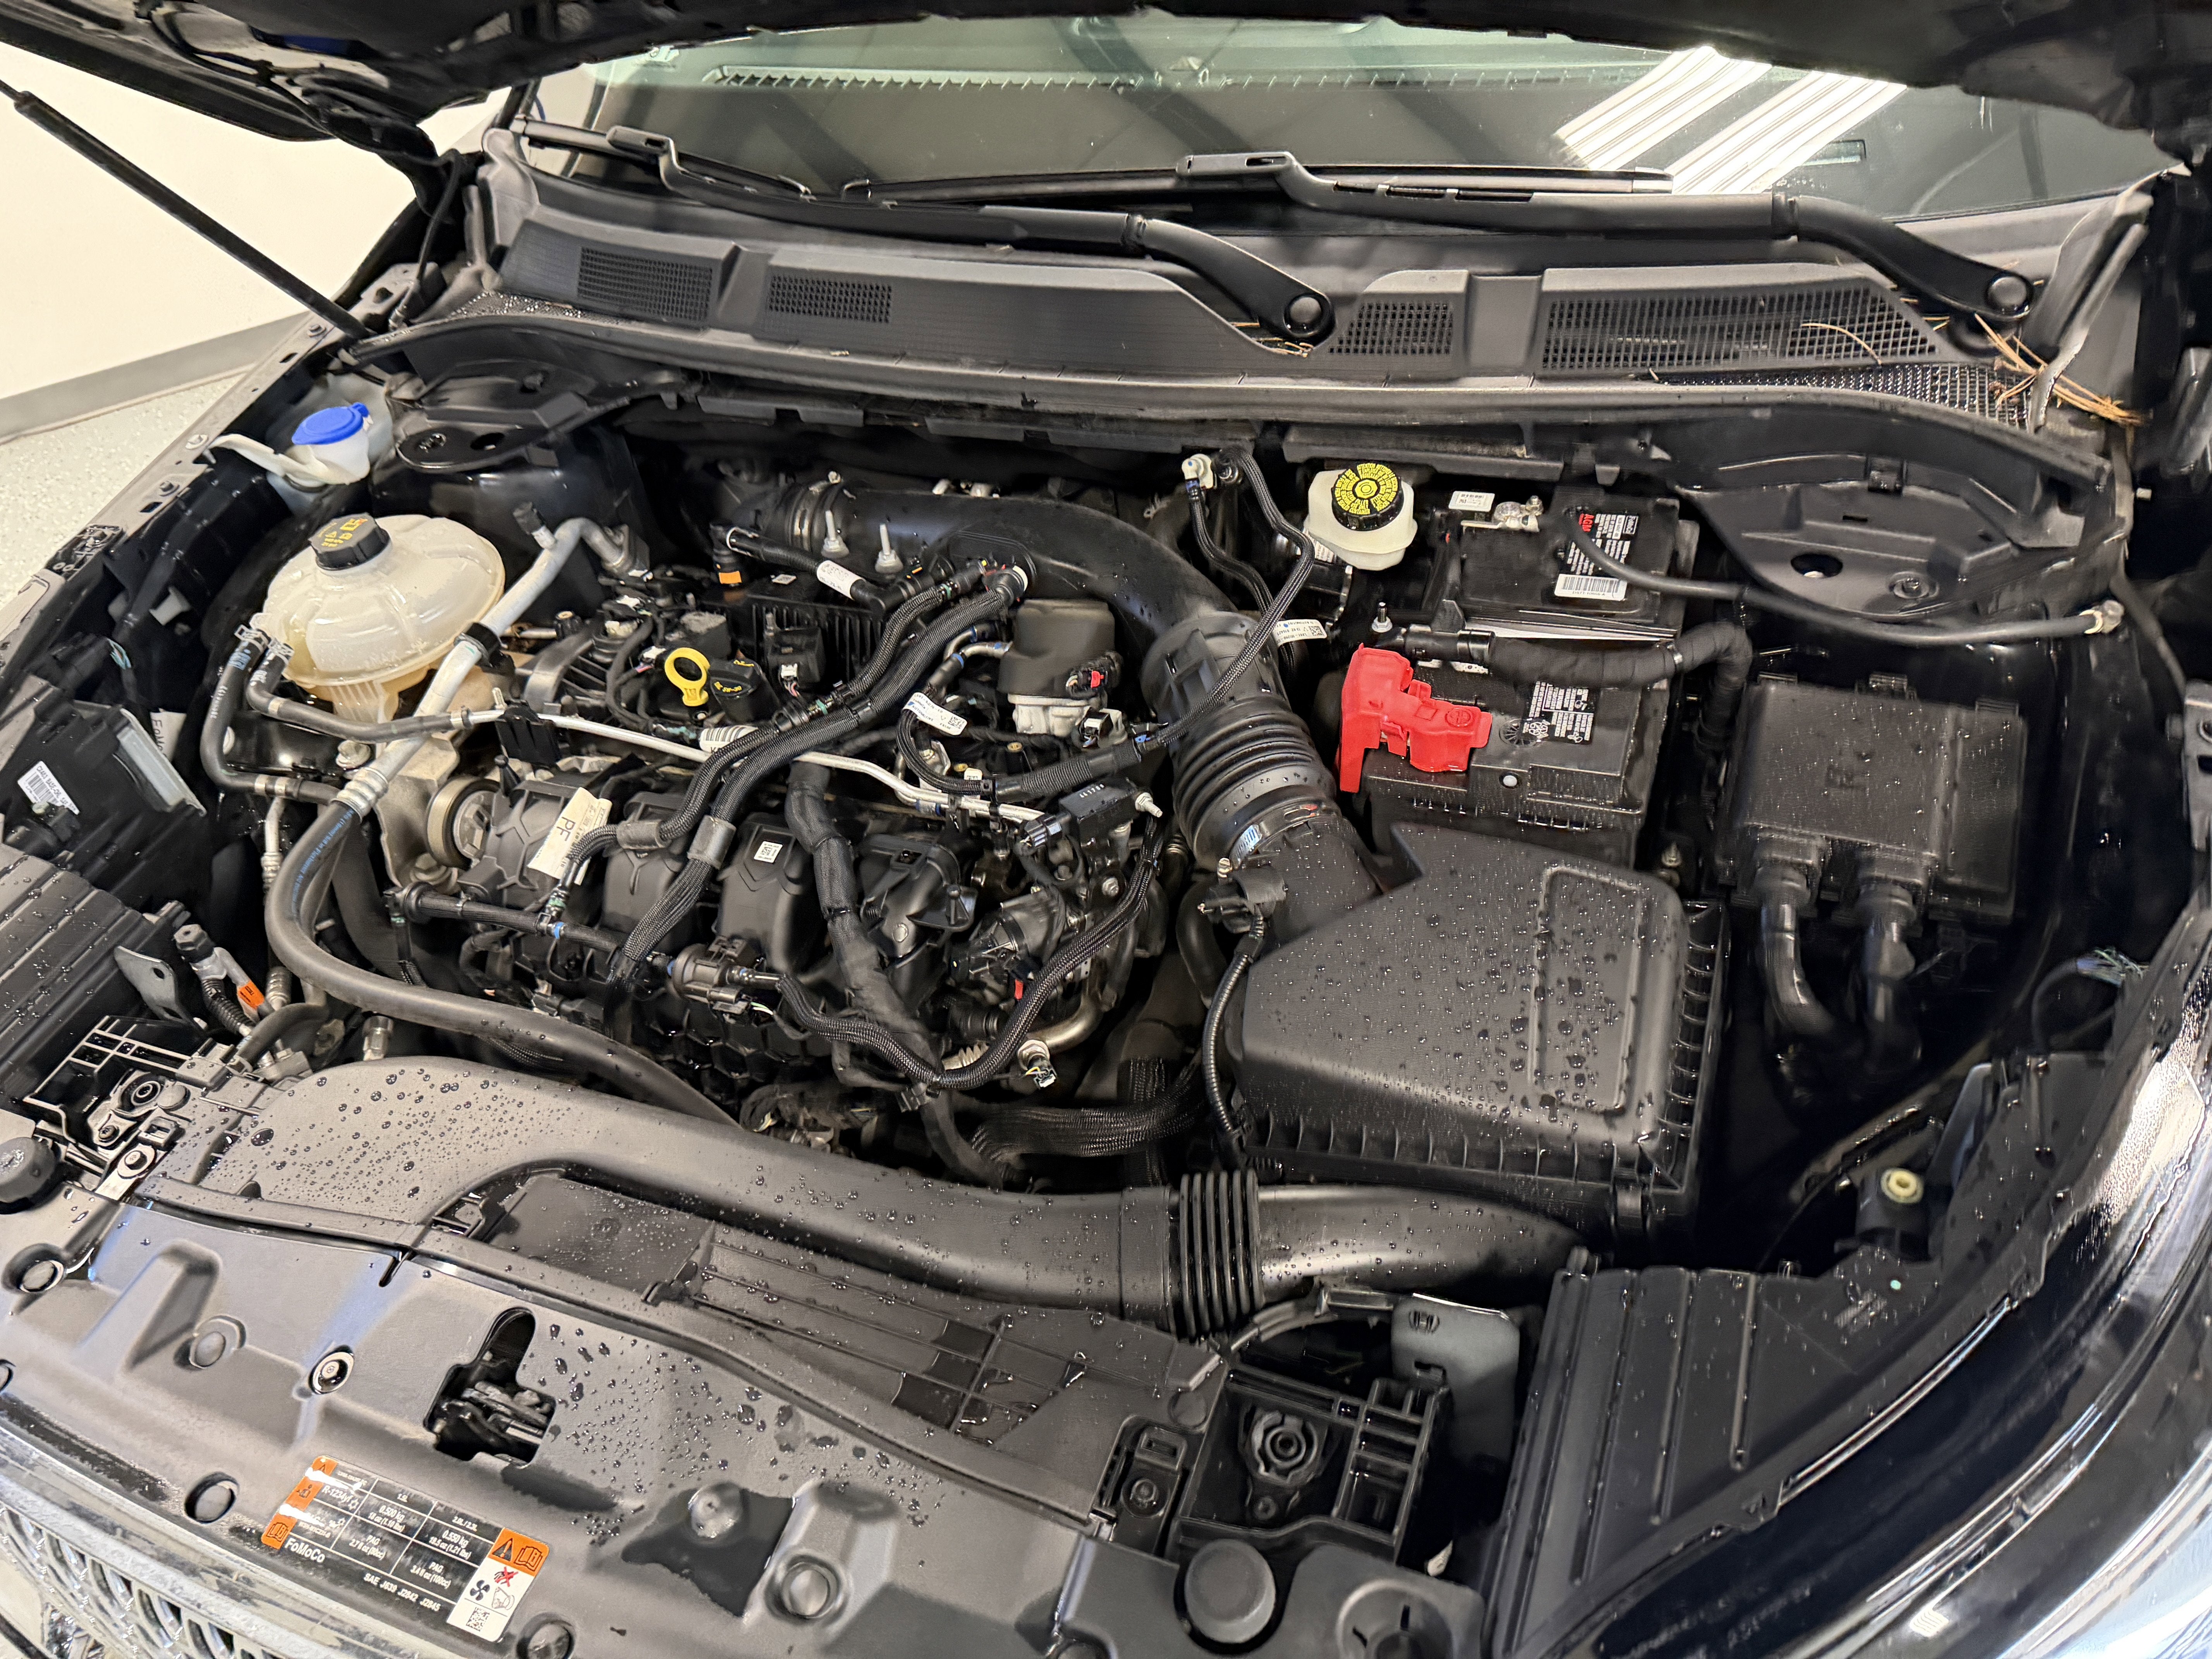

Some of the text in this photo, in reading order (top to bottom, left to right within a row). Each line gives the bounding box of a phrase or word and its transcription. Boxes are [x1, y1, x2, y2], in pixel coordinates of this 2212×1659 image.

[1582, 514, 1594, 532] AGM
[557, 816, 577, 842] PF
[321, 1485, 354, 1503] R-1234yf
[379, 1505, 405, 1523] 0.500 kg
[366, 1535, 381, 1546] PAG
[442, 1530, 469, 1548] 0.550 kg
[285, 1537, 325, 1563] FoMoCo
[428, 1561, 444, 1573] PAG
[363, 1573, 381, 1586] SAE
[380, 1581, 398, 1593] J639
